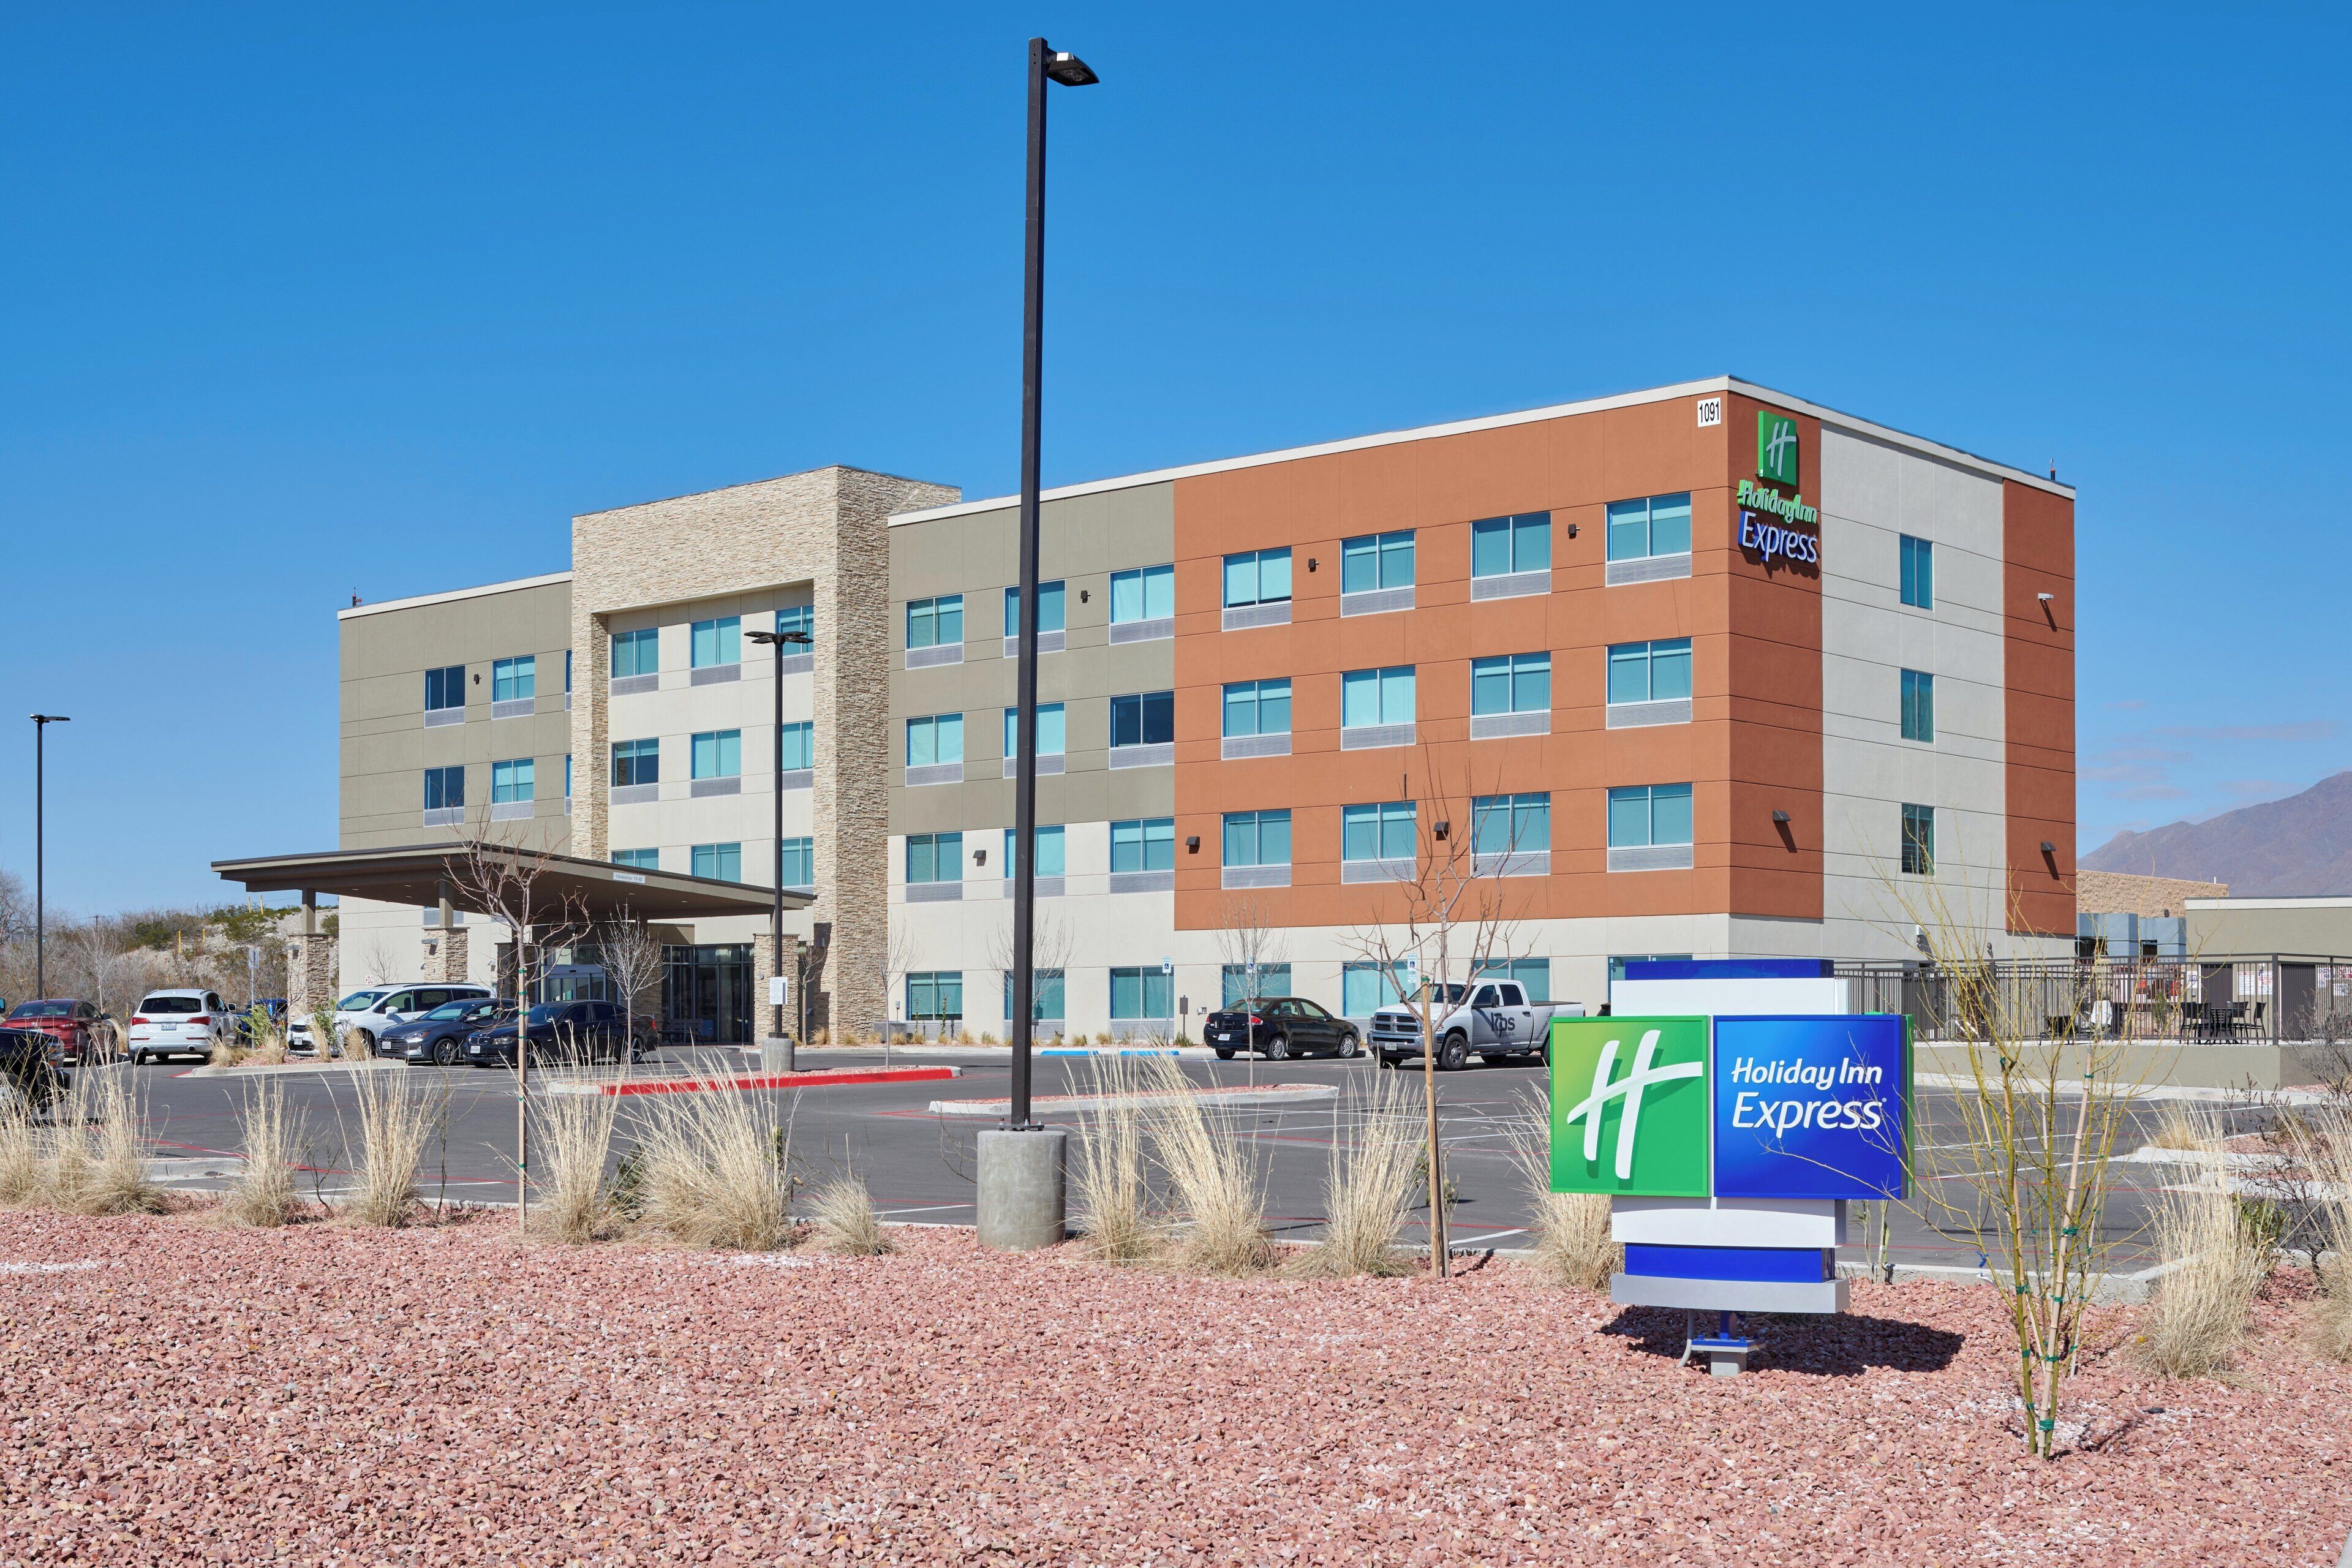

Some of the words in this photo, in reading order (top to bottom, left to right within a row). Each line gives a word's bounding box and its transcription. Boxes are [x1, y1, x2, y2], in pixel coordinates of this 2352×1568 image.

[1699, 401, 1719, 423] 1091
[1738, 480, 1794, 524] Holiday
[1739, 511, 1817, 563] Express
[1731, 1057, 1836, 1090] Holiday
[1839, 1057, 1883, 1085] Inn
[1732, 1092, 1883, 1139] Express
